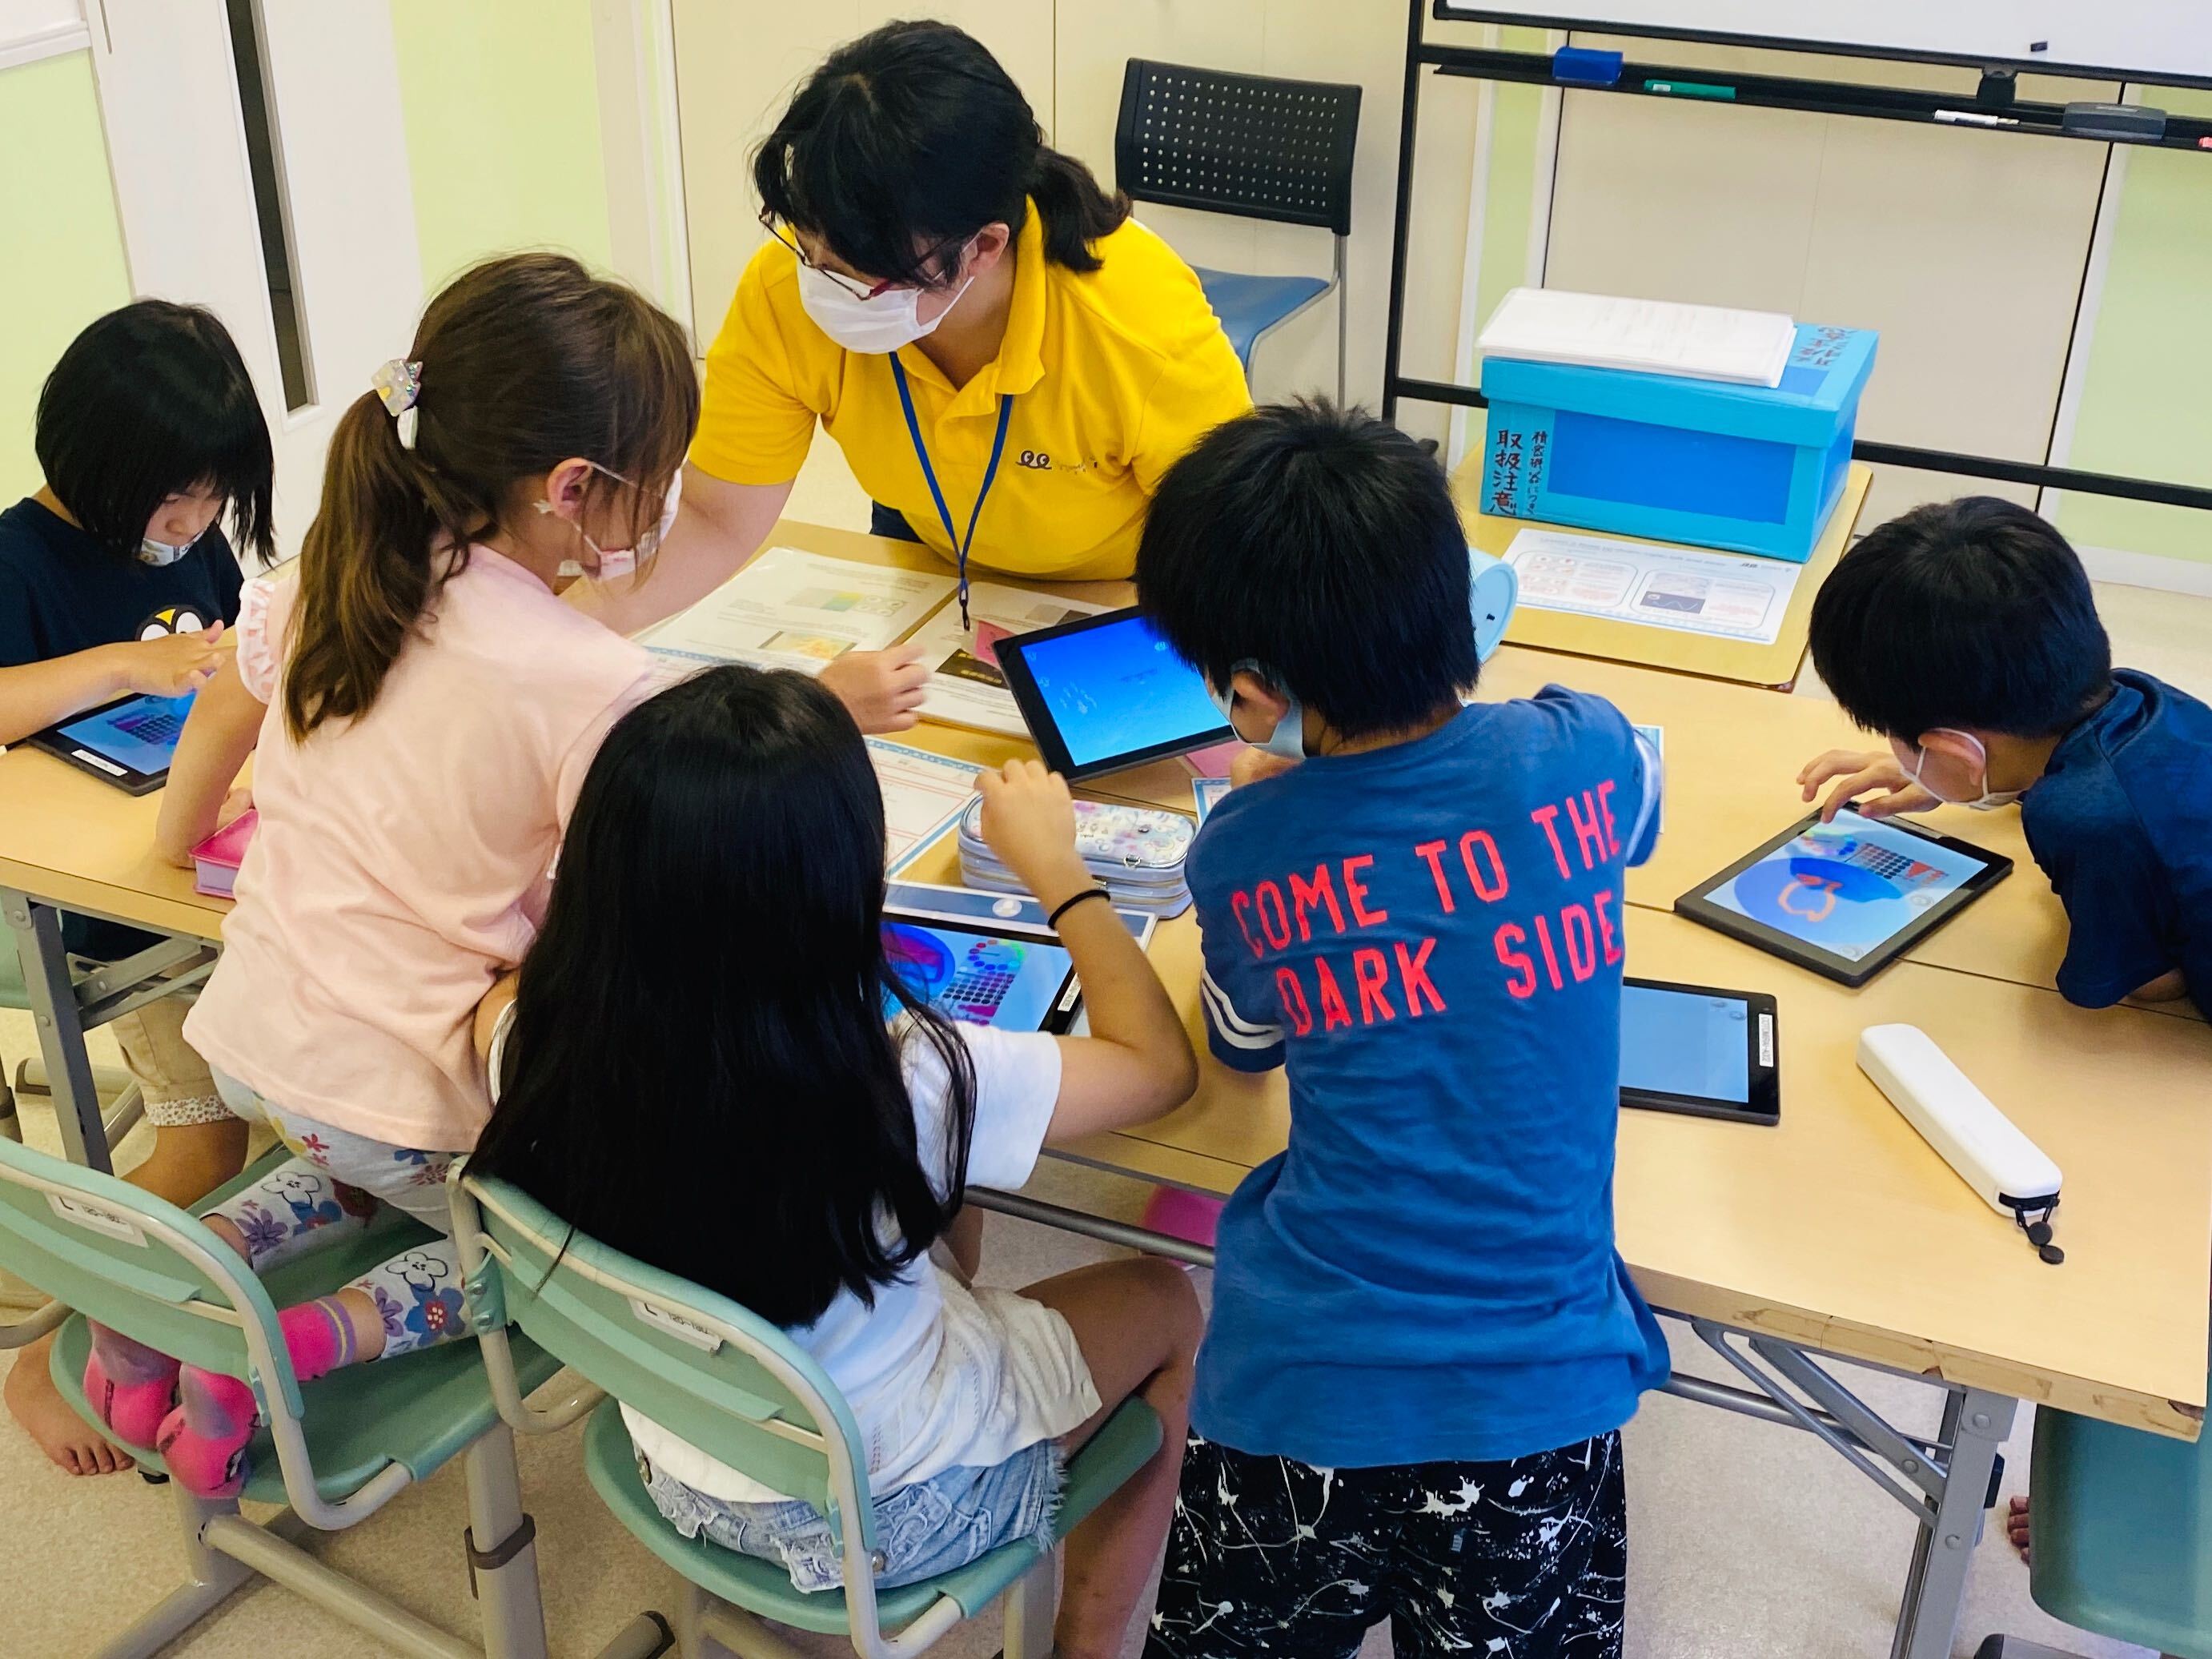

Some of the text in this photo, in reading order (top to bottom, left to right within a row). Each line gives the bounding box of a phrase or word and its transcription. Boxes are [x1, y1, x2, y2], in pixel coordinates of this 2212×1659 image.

[1489, 429, 1524, 516] 取扱注意
[1231, 779, 1620, 958] COME TO THE
[1275, 890, 1623, 1037] DARK SIDE
